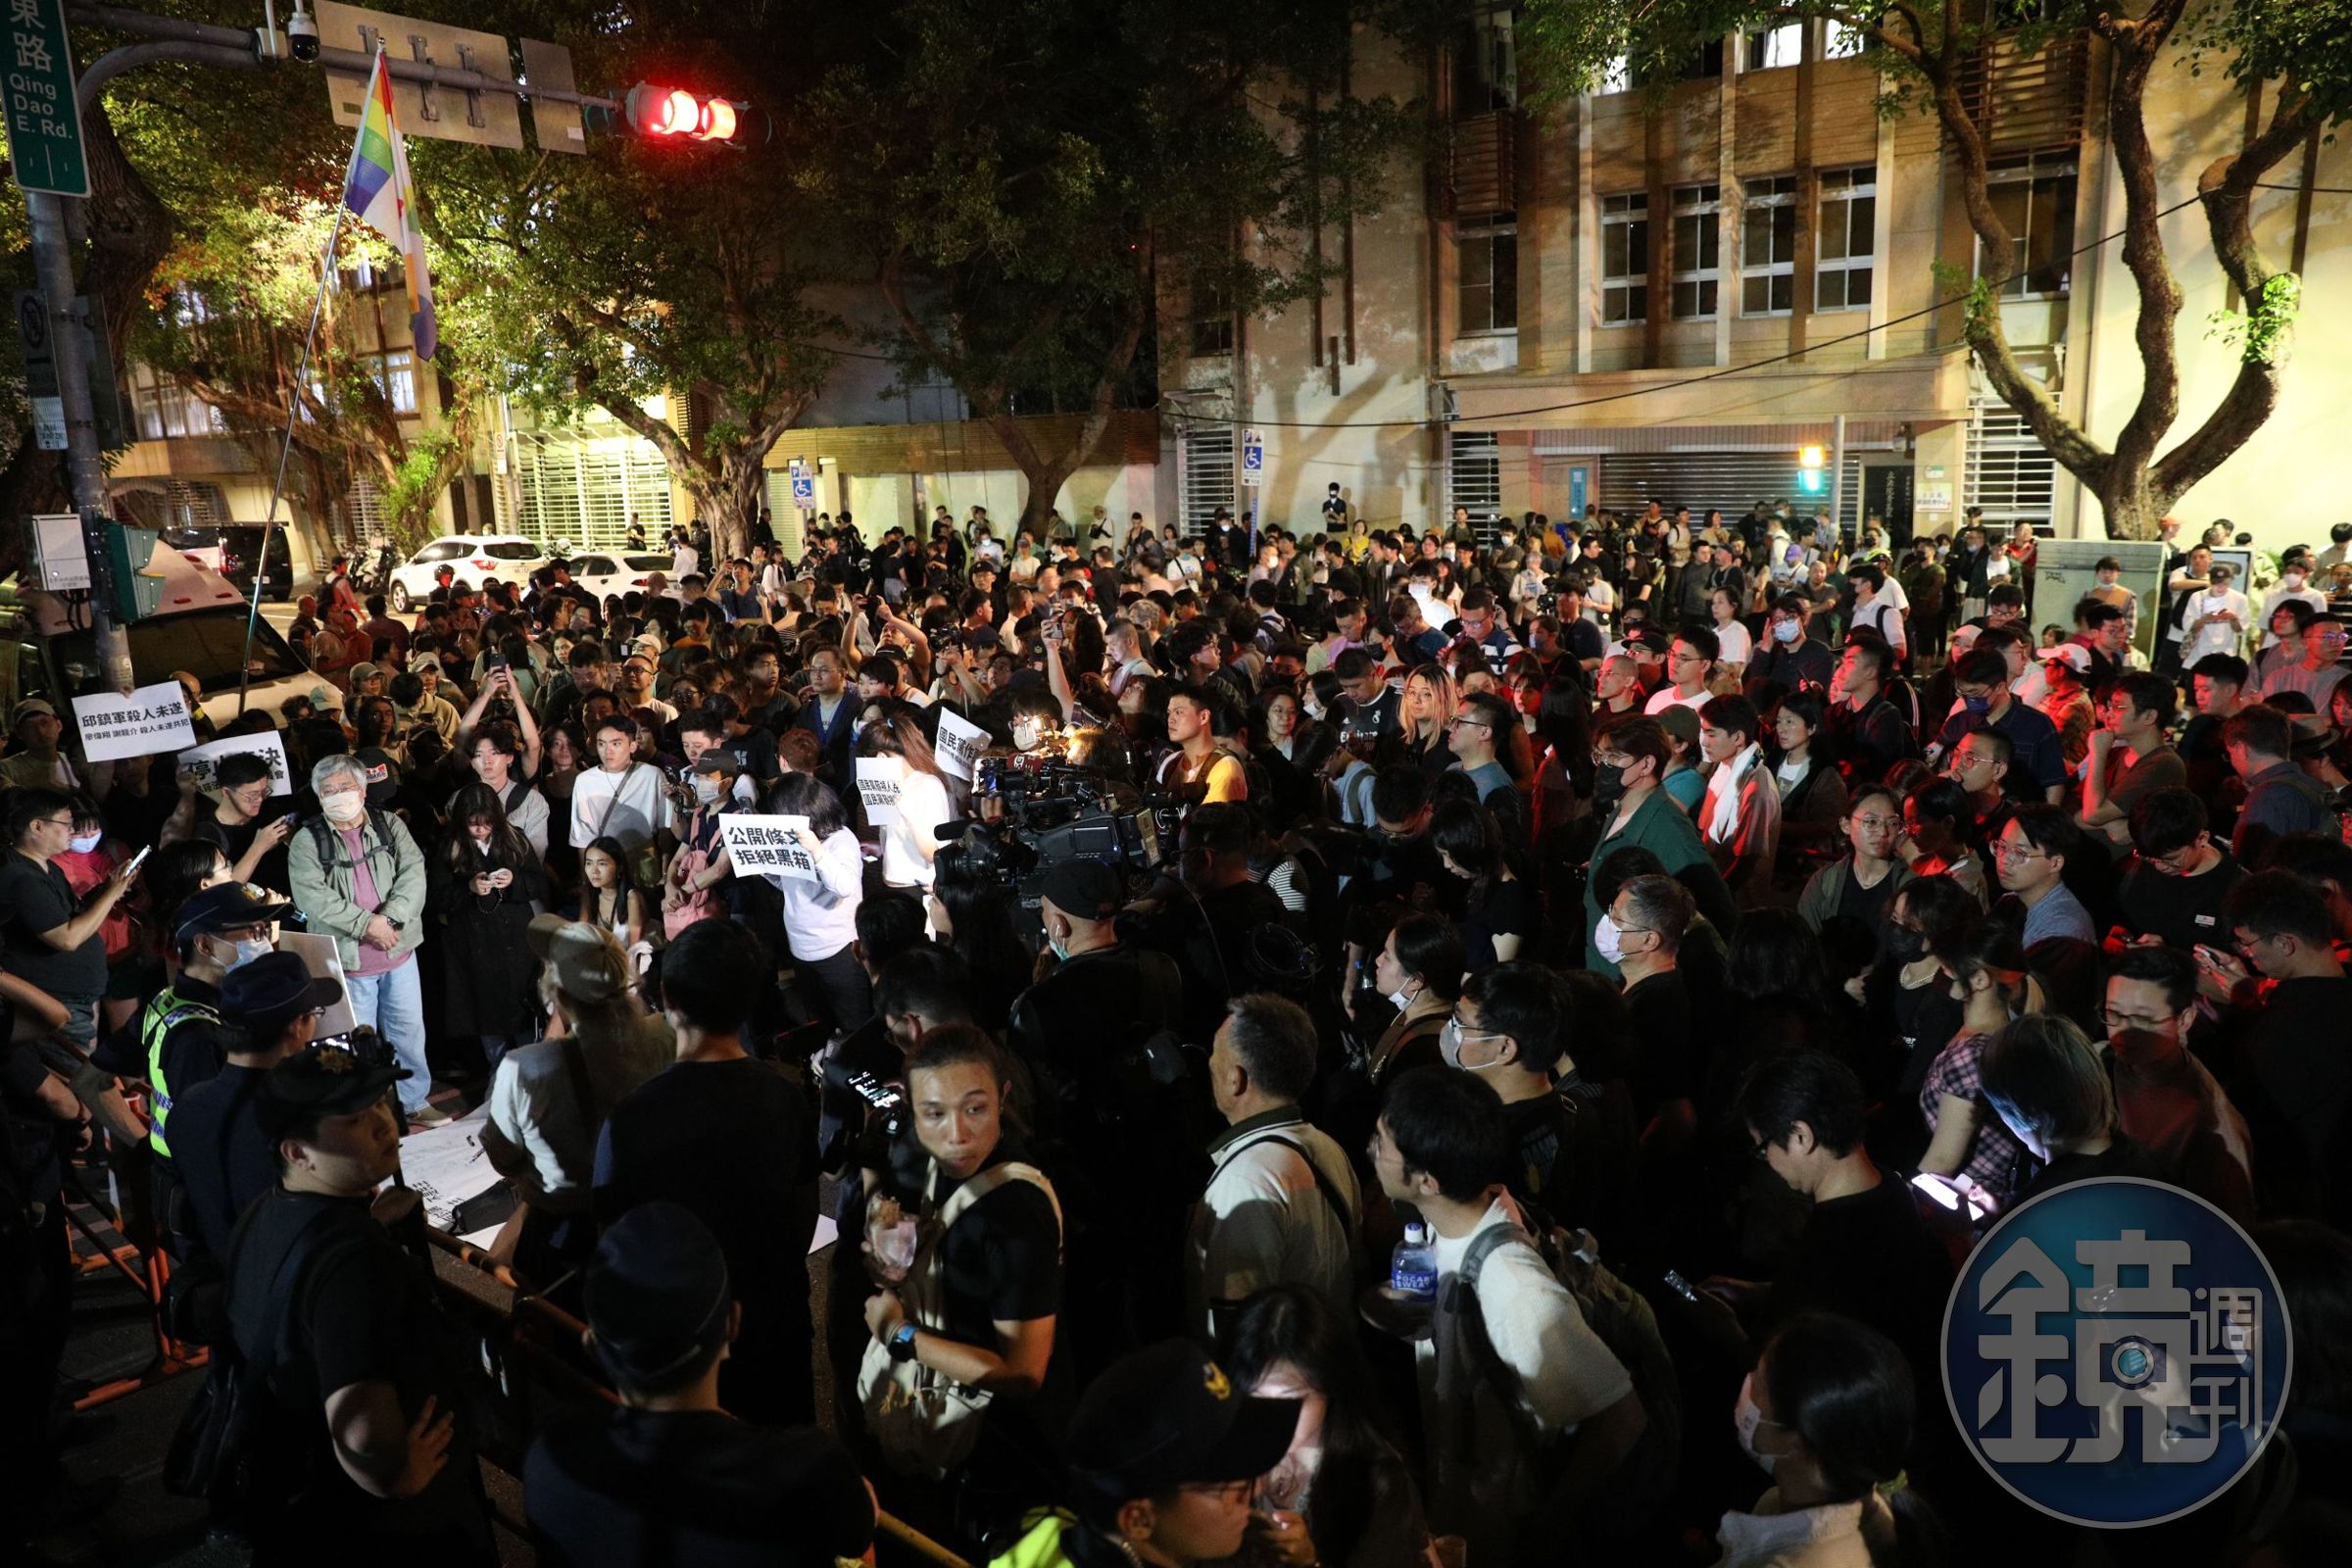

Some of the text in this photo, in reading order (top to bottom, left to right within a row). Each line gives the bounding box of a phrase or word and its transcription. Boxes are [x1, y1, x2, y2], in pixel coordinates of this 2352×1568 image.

[10, 73, 57, 100] Qing
[14, 94, 55, 116] Dao
[17, 115, 74, 139] E. Rd.
[81, 702, 184, 727] 邱鎮軍殺人未遂
[728, 826, 800, 846] 公開條文
[735, 849, 811, 871] 拒絕黑箱
